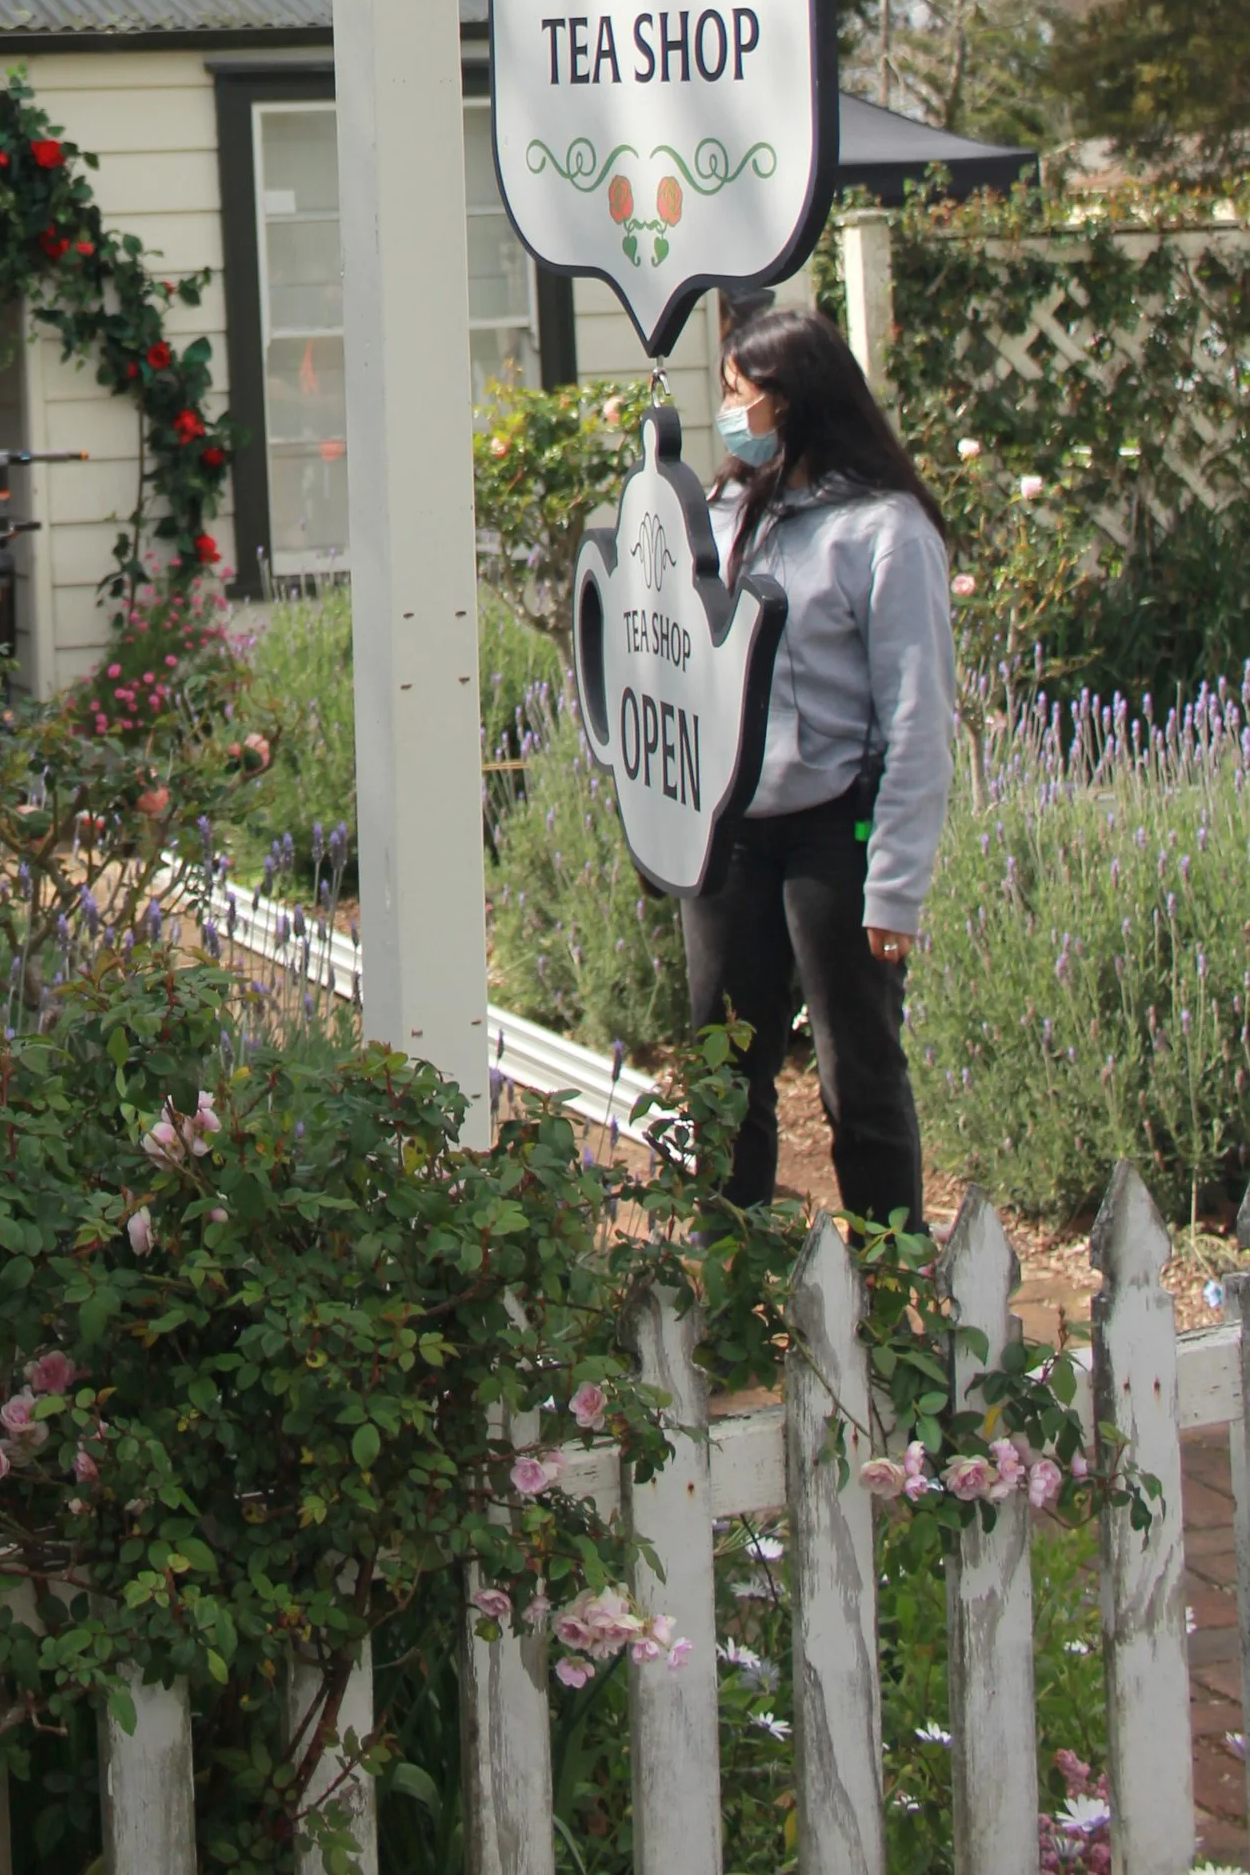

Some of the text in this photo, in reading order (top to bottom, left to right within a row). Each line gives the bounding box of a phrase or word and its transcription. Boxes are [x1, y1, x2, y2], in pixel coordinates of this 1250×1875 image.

[542, 7, 760, 85] TEA SHOP
[623, 609, 692, 673] TEA SHOP
[620, 686, 702, 812] OPEN
